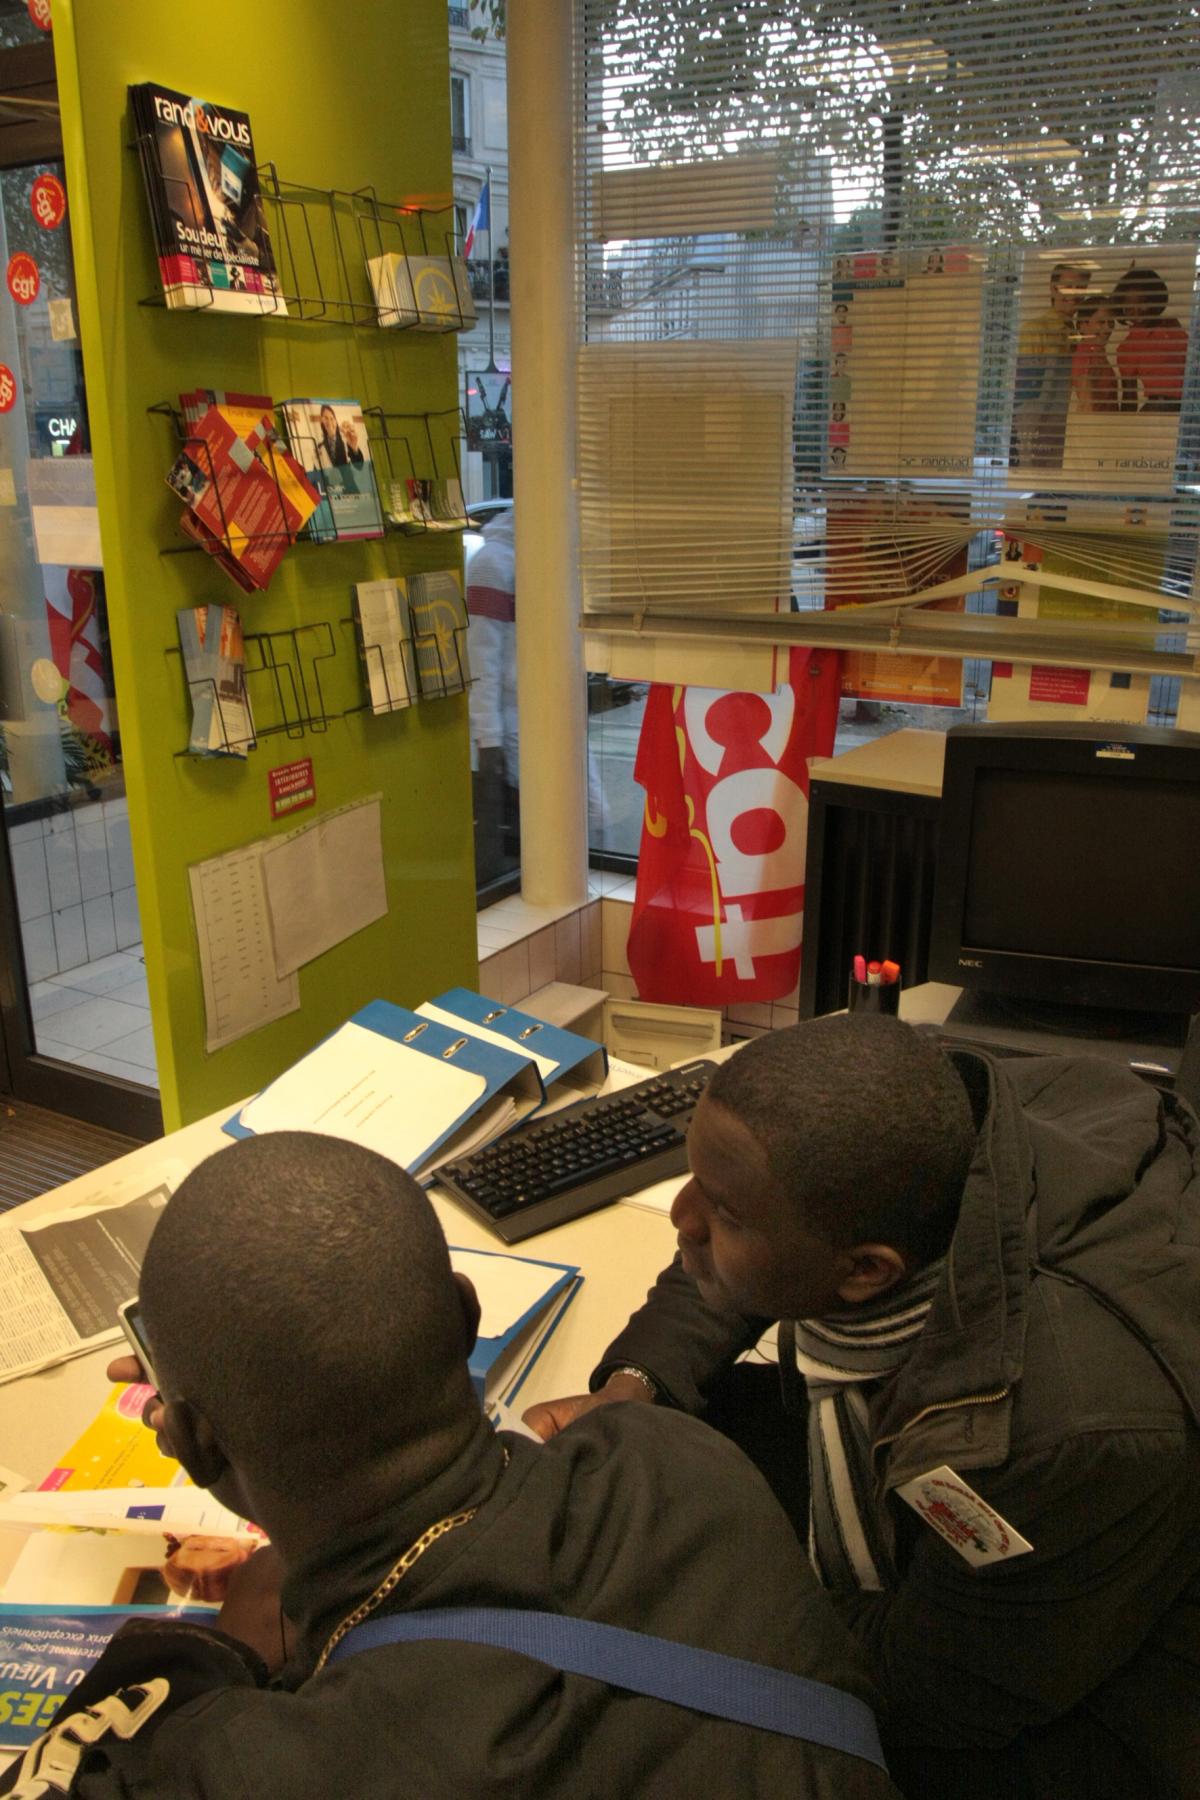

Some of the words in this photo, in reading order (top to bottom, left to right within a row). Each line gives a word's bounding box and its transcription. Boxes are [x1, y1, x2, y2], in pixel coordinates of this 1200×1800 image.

[154, 95, 251, 145] rand&vous
[176, 221, 228, 250] Soudeur
[12, 275, 36, 300] cgt
[1115, 456, 1170, 469] randstad
[958, 959, 984, 968] NEC
[2, 1625, 86, 1642] exceptionnels
[88, 1633, 114, 1645] prix
